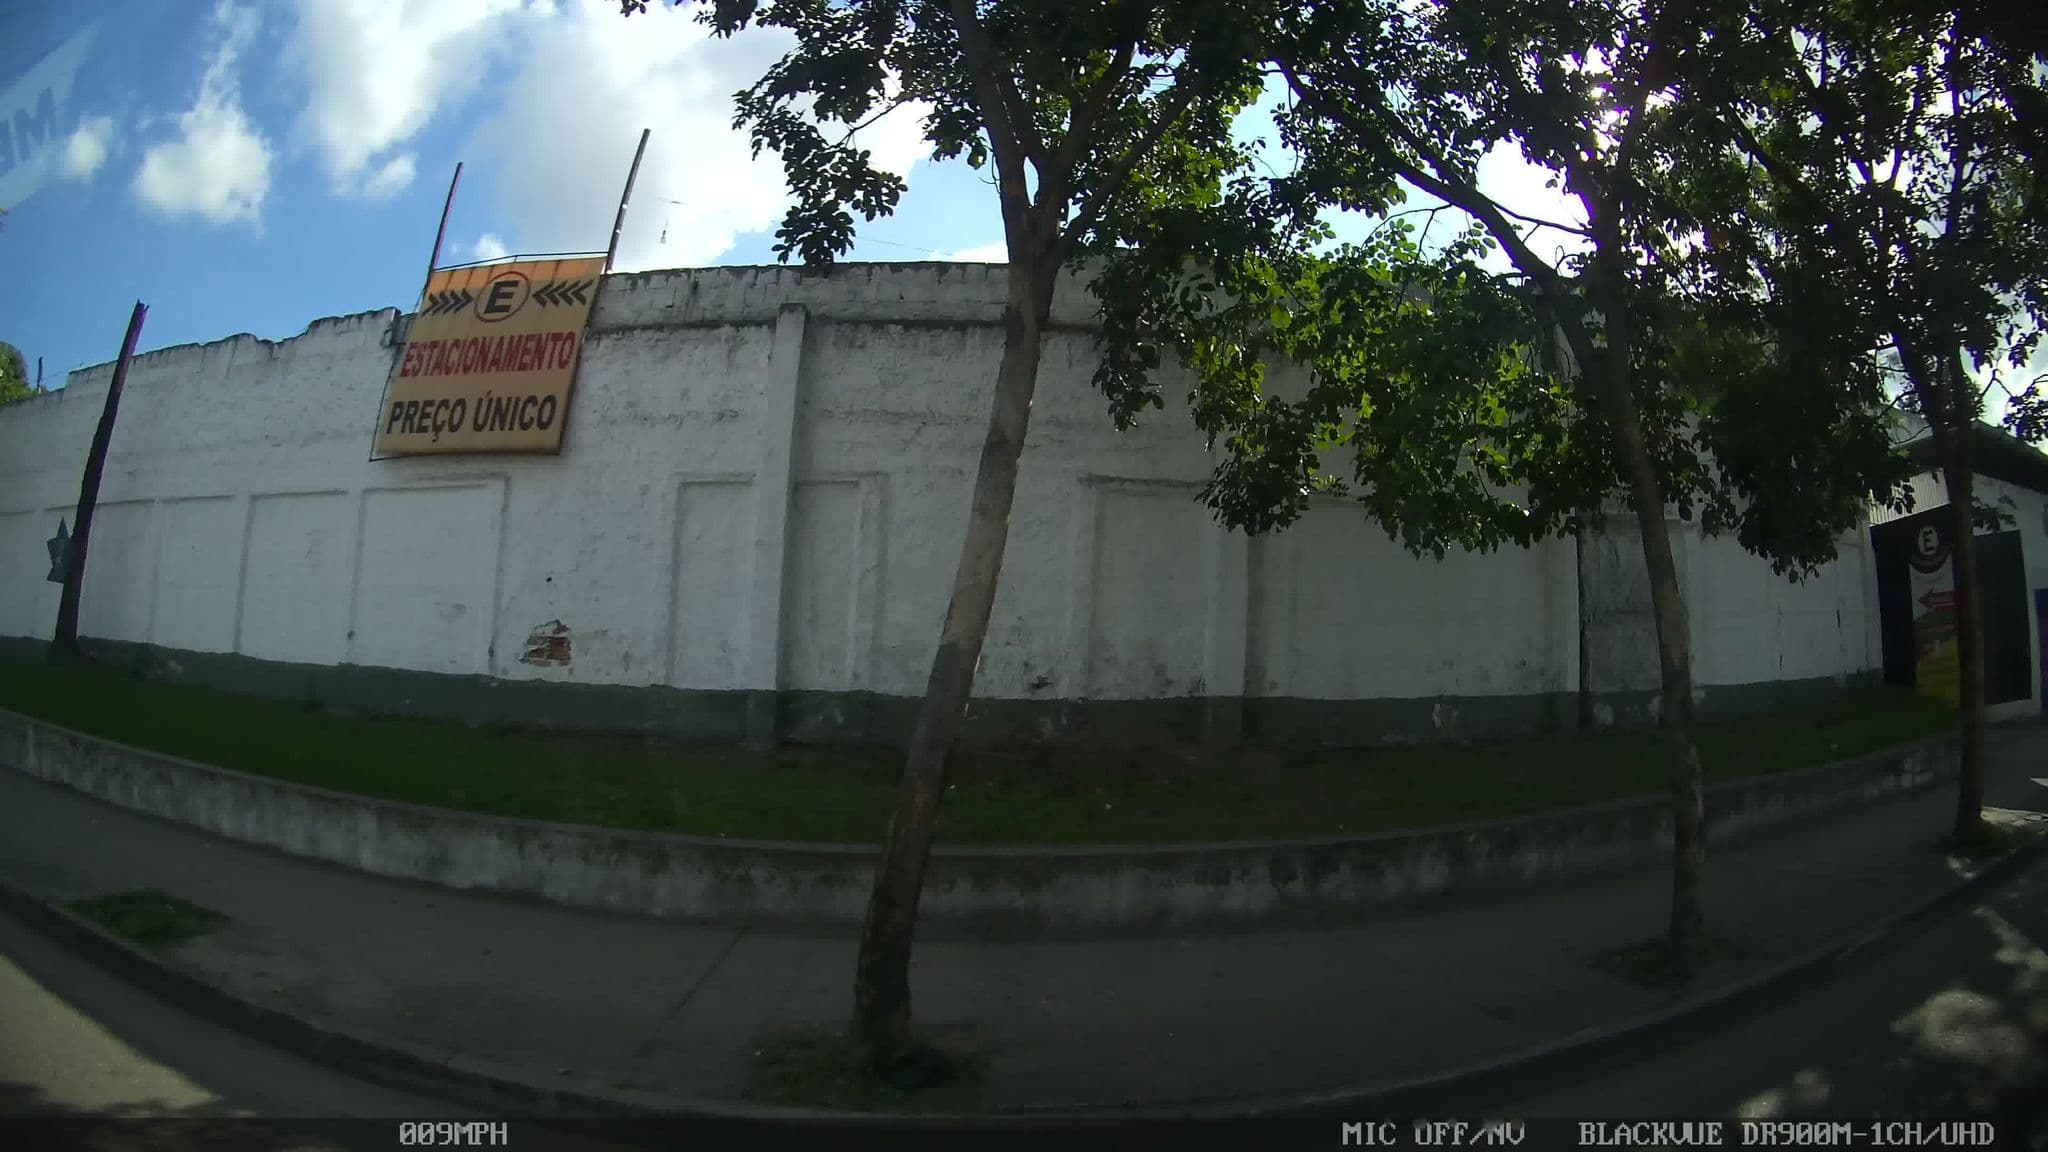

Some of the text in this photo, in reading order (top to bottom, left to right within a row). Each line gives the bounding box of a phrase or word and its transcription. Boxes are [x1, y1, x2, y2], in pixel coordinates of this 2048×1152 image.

[484, 280, 519, 314] E
[400, 331, 577, 378] ESTACIONAMENTO
[386, 390, 557, 443] PREÇO ÚNICO
